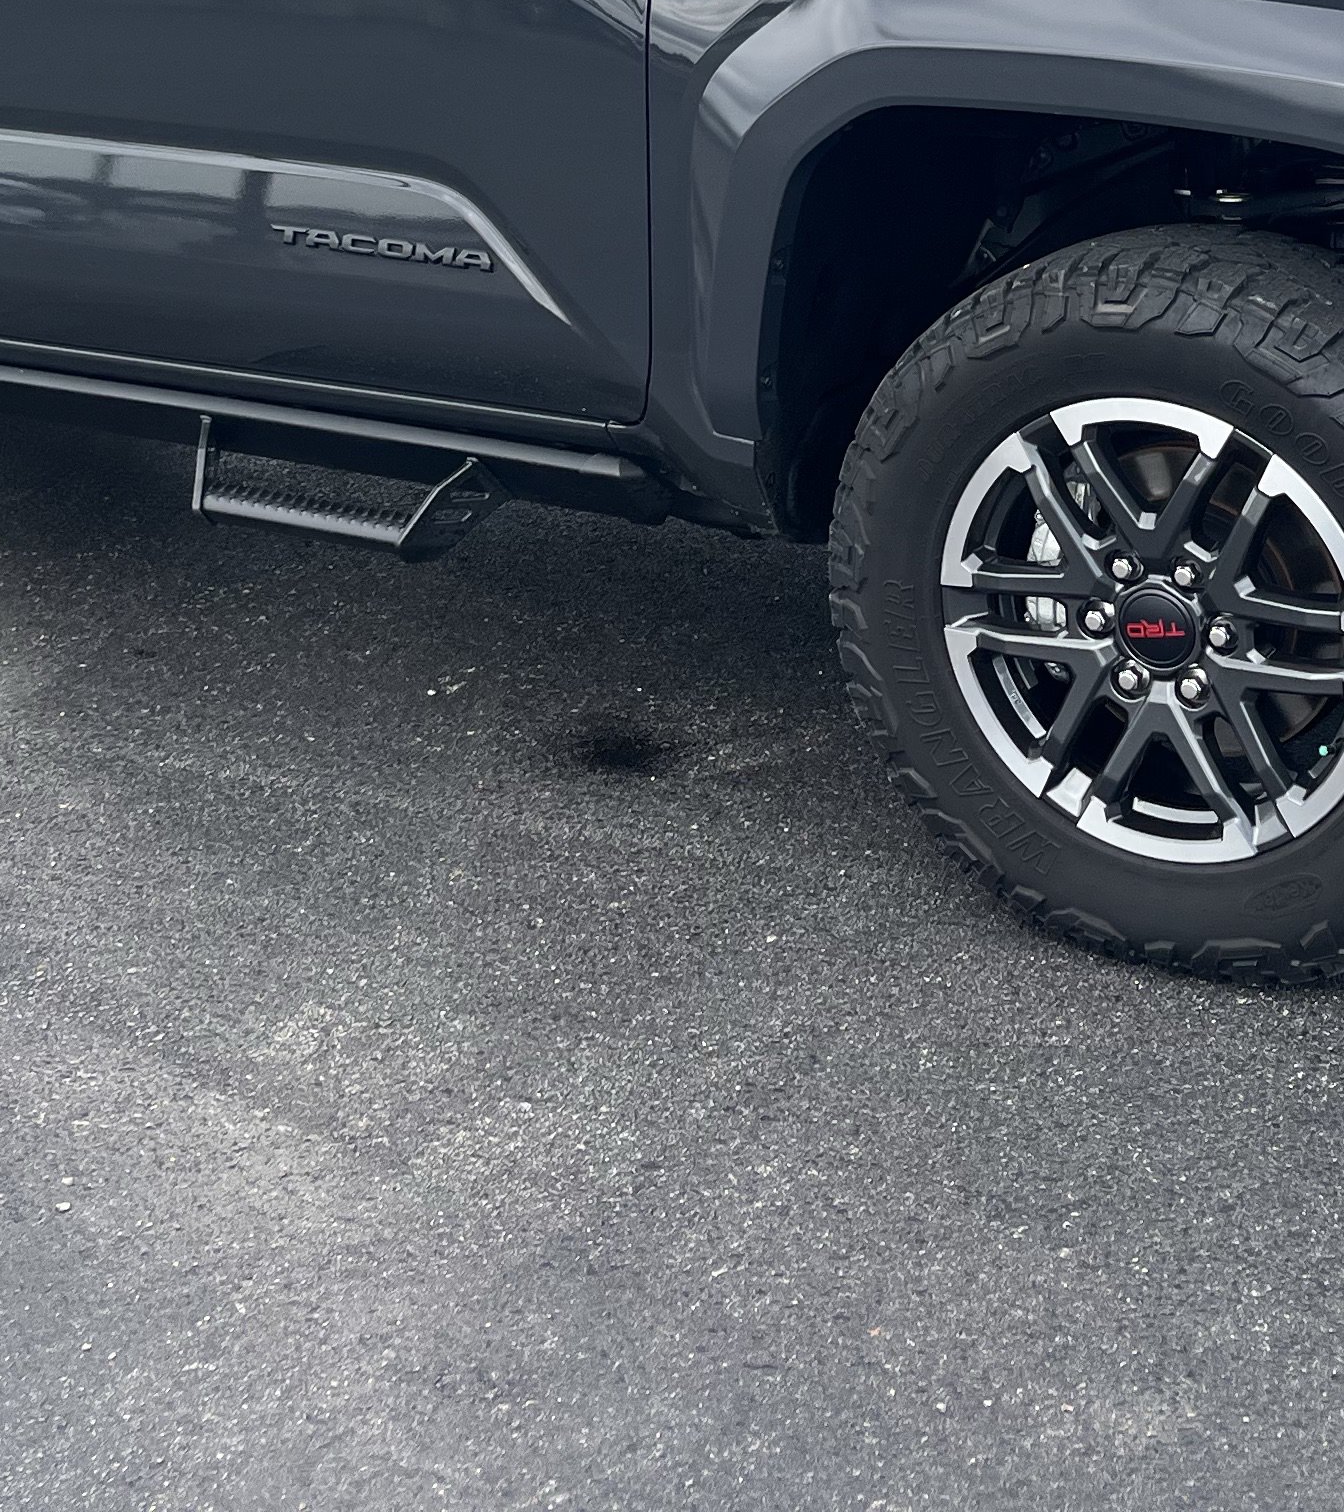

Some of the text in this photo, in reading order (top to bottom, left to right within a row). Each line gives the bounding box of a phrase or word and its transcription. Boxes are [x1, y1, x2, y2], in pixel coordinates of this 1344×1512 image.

[269, 223, 494, 273] TACOMA
[1126, 618, 1186, 639] TRD
[883, 579, 1061, 875] WRANGLER
